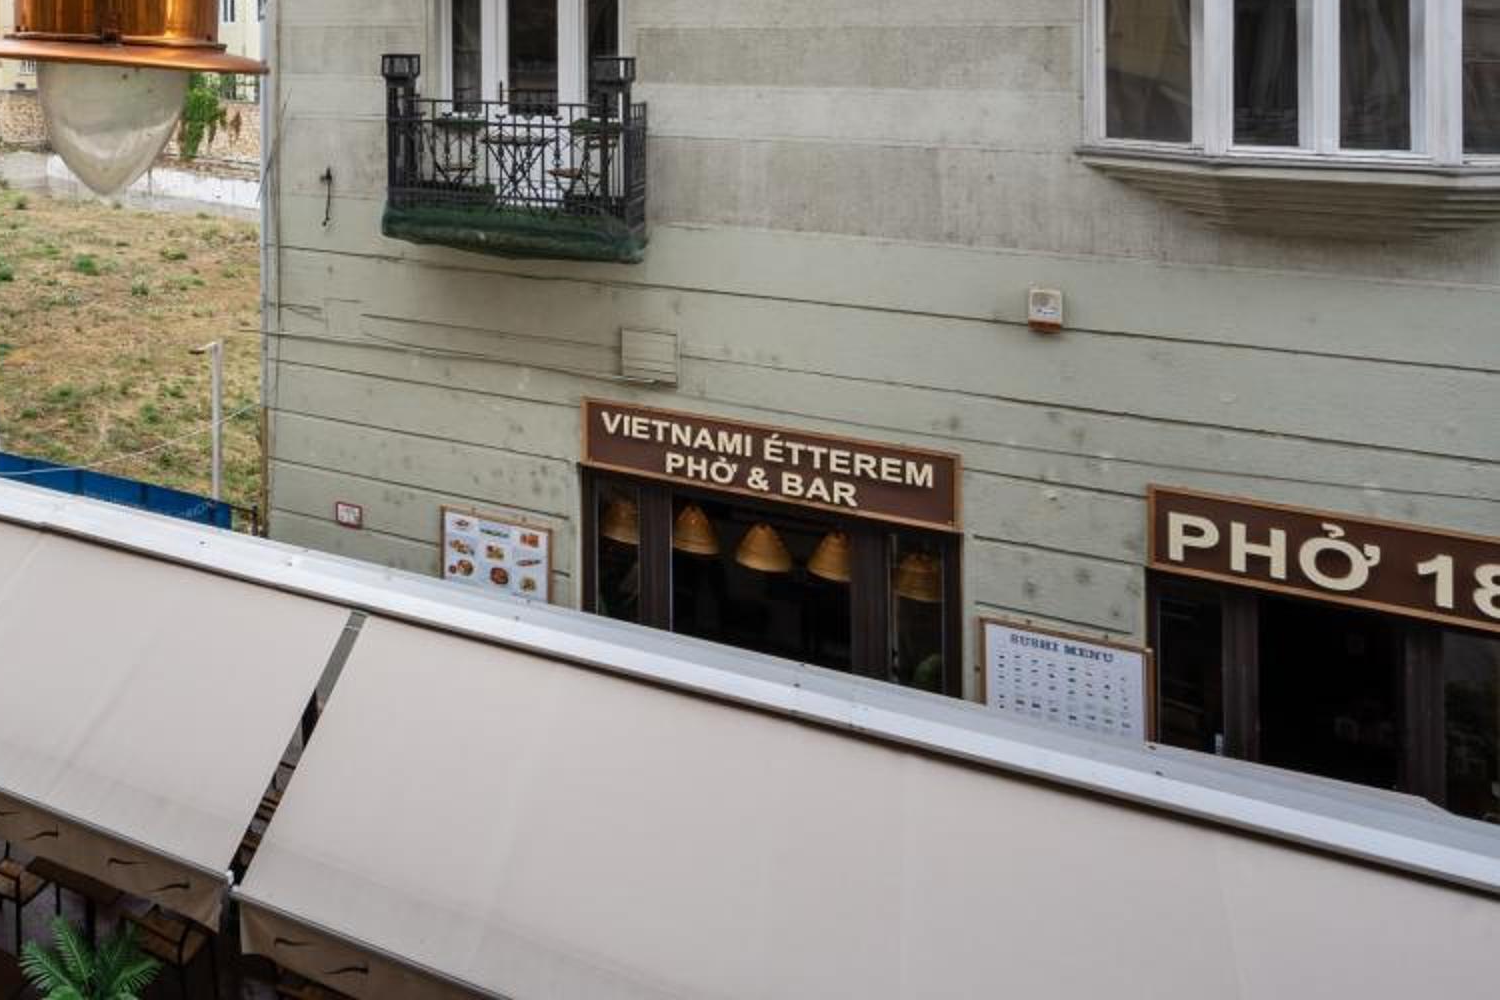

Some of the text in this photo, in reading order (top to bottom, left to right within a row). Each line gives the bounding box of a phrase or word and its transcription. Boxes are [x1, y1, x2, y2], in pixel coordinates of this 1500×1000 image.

[601, 411, 934, 489] VIETNAMI ÉTTEREM
[747, 466, 770, 491] &
[781, 471, 859, 508] BAR
[1167, 511, 1381, 591] PHỞ
[1010, 633, 1114, 663] SUSHI MENU
